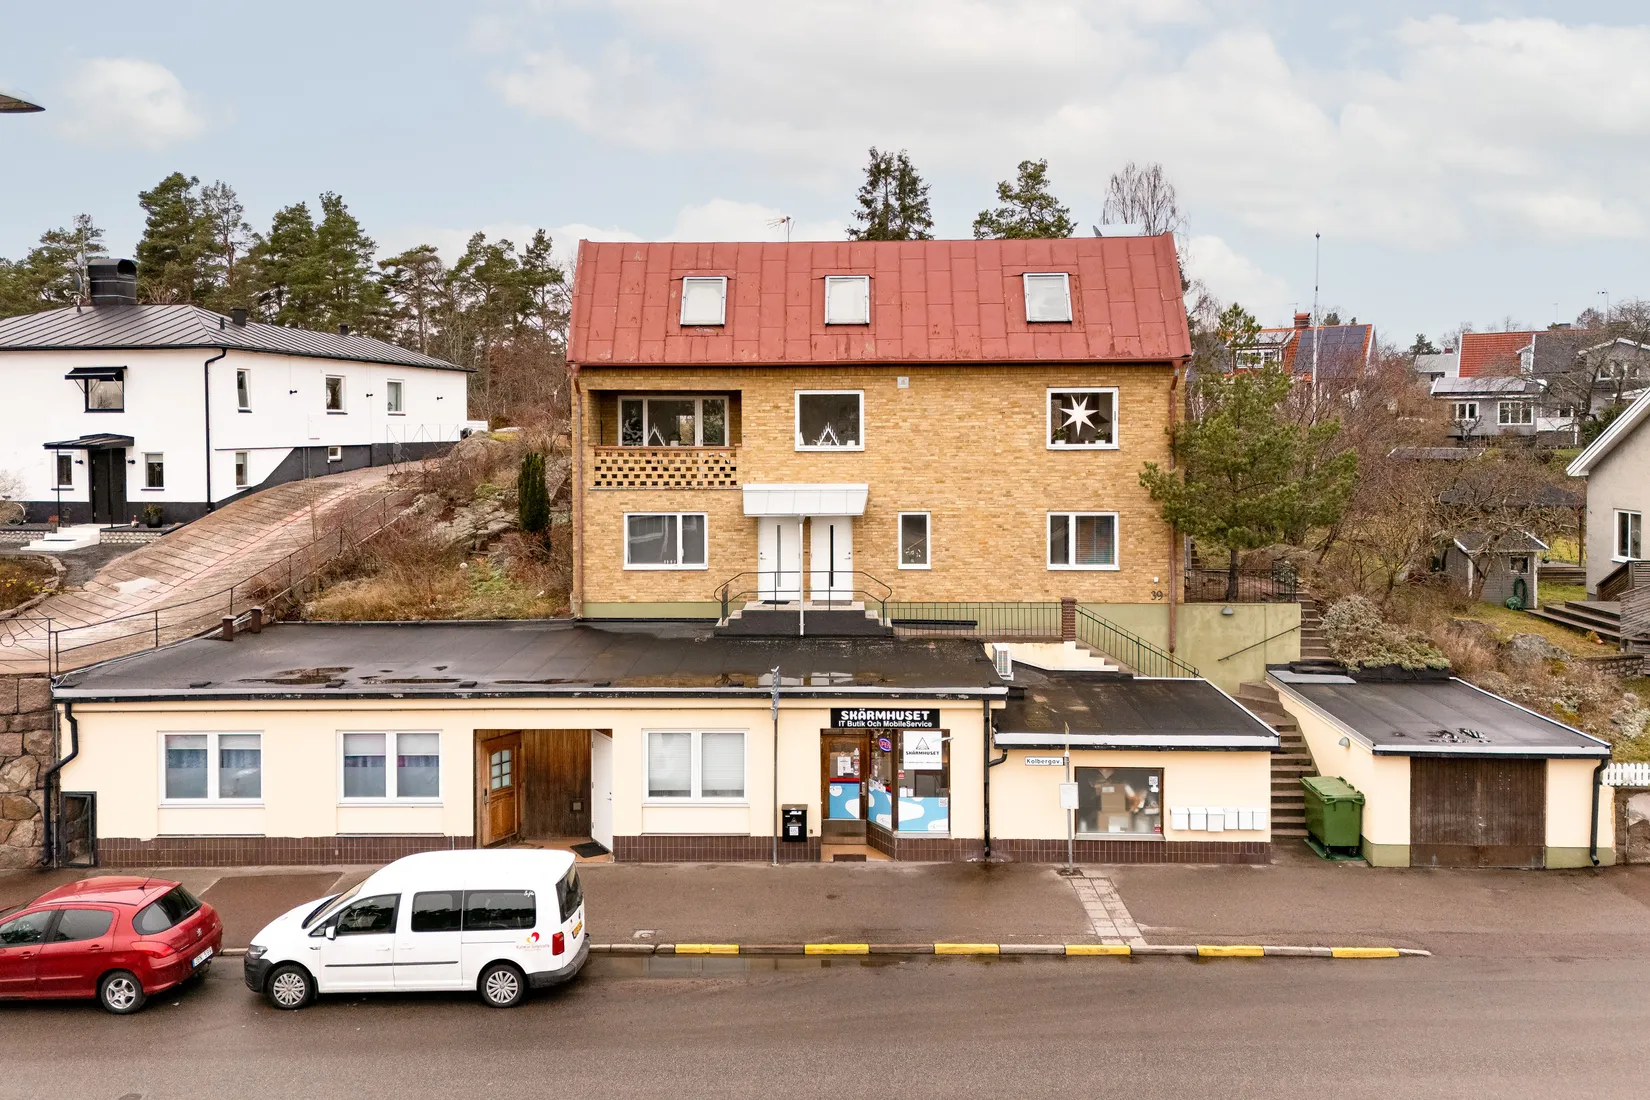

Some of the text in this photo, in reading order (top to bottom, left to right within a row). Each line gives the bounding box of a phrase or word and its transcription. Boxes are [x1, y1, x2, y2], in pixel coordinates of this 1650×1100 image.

[1151, 590, 1163, 601] 39
[840, 708, 930, 720] SKÄRMHUSET
[883, 720, 933, 728] MobileService
